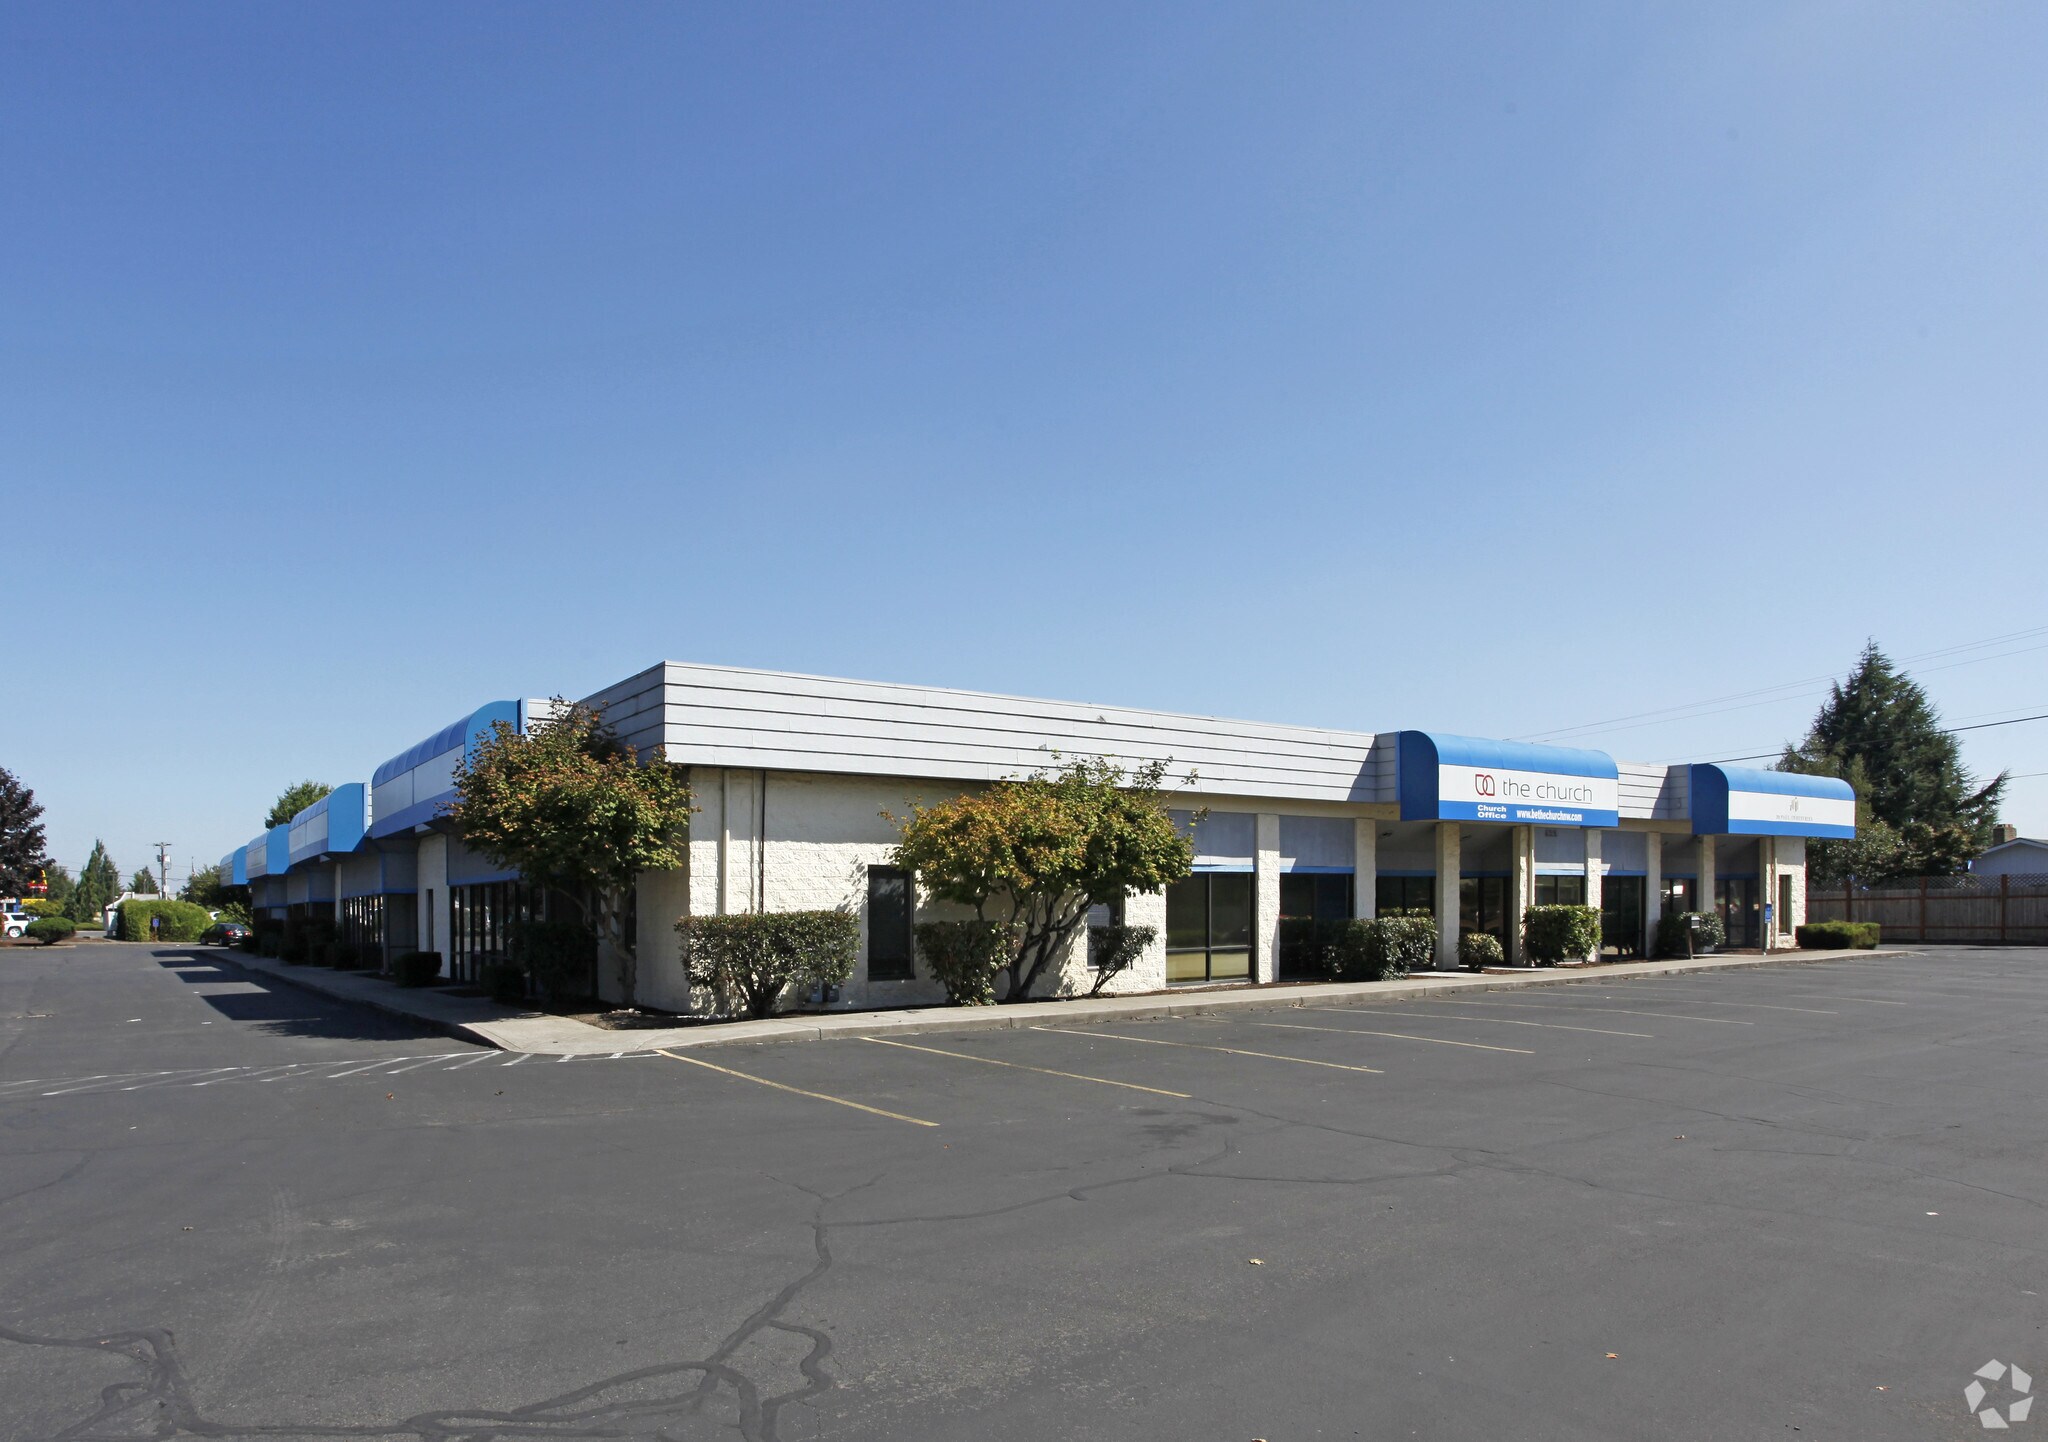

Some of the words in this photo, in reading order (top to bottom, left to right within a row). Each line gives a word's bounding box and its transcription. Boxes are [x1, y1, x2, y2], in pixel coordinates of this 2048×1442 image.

[1502, 778, 1531, 798] the
[1536, 781, 1593, 802] church
[1477, 804, 1507, 812] Church
[1477, 811, 1507, 819] Office
